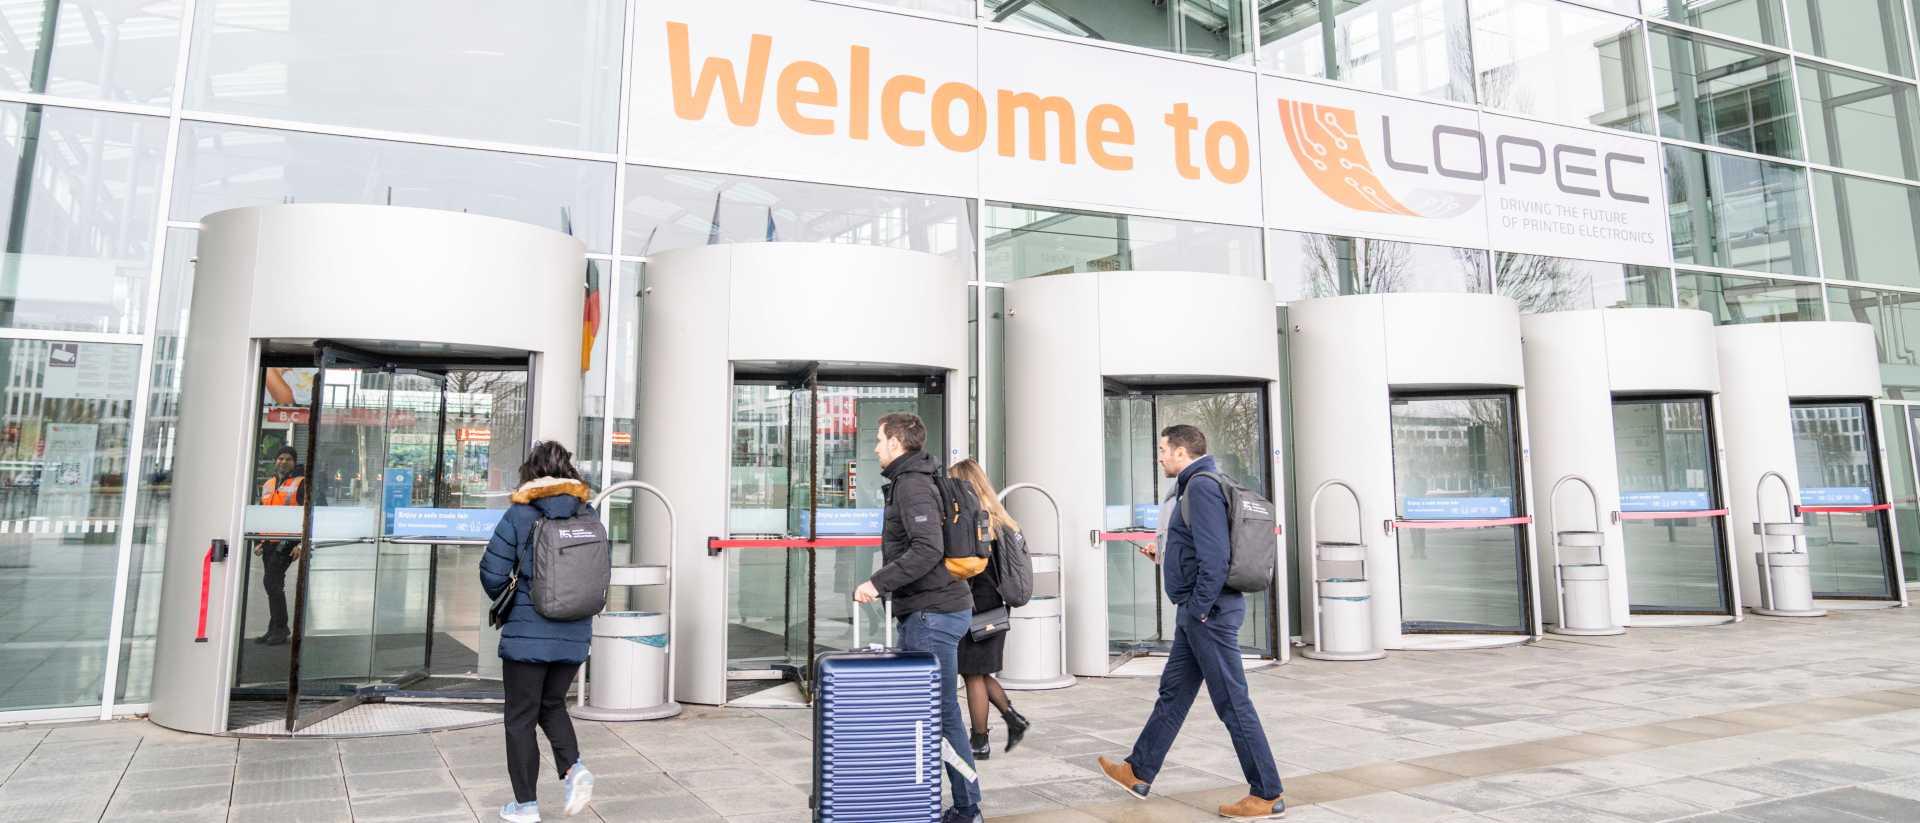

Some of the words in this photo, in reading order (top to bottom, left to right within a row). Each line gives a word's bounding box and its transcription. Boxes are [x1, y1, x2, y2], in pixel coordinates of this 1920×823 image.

[666, 21, 1135, 171] Welcome
[1164, 103, 1250, 185] to
[1382, 115, 1650, 204] LOPEC
[1500, 198, 1551, 215] DRIVING
[1556, 205, 1577, 218] THE
[1583, 208, 1628, 225] FUTURE
[1502, 215, 1518, 228] OF
[1523, 218, 1575, 235] PRINTED
[1579, 223, 1655, 244] ELECTRONICS
